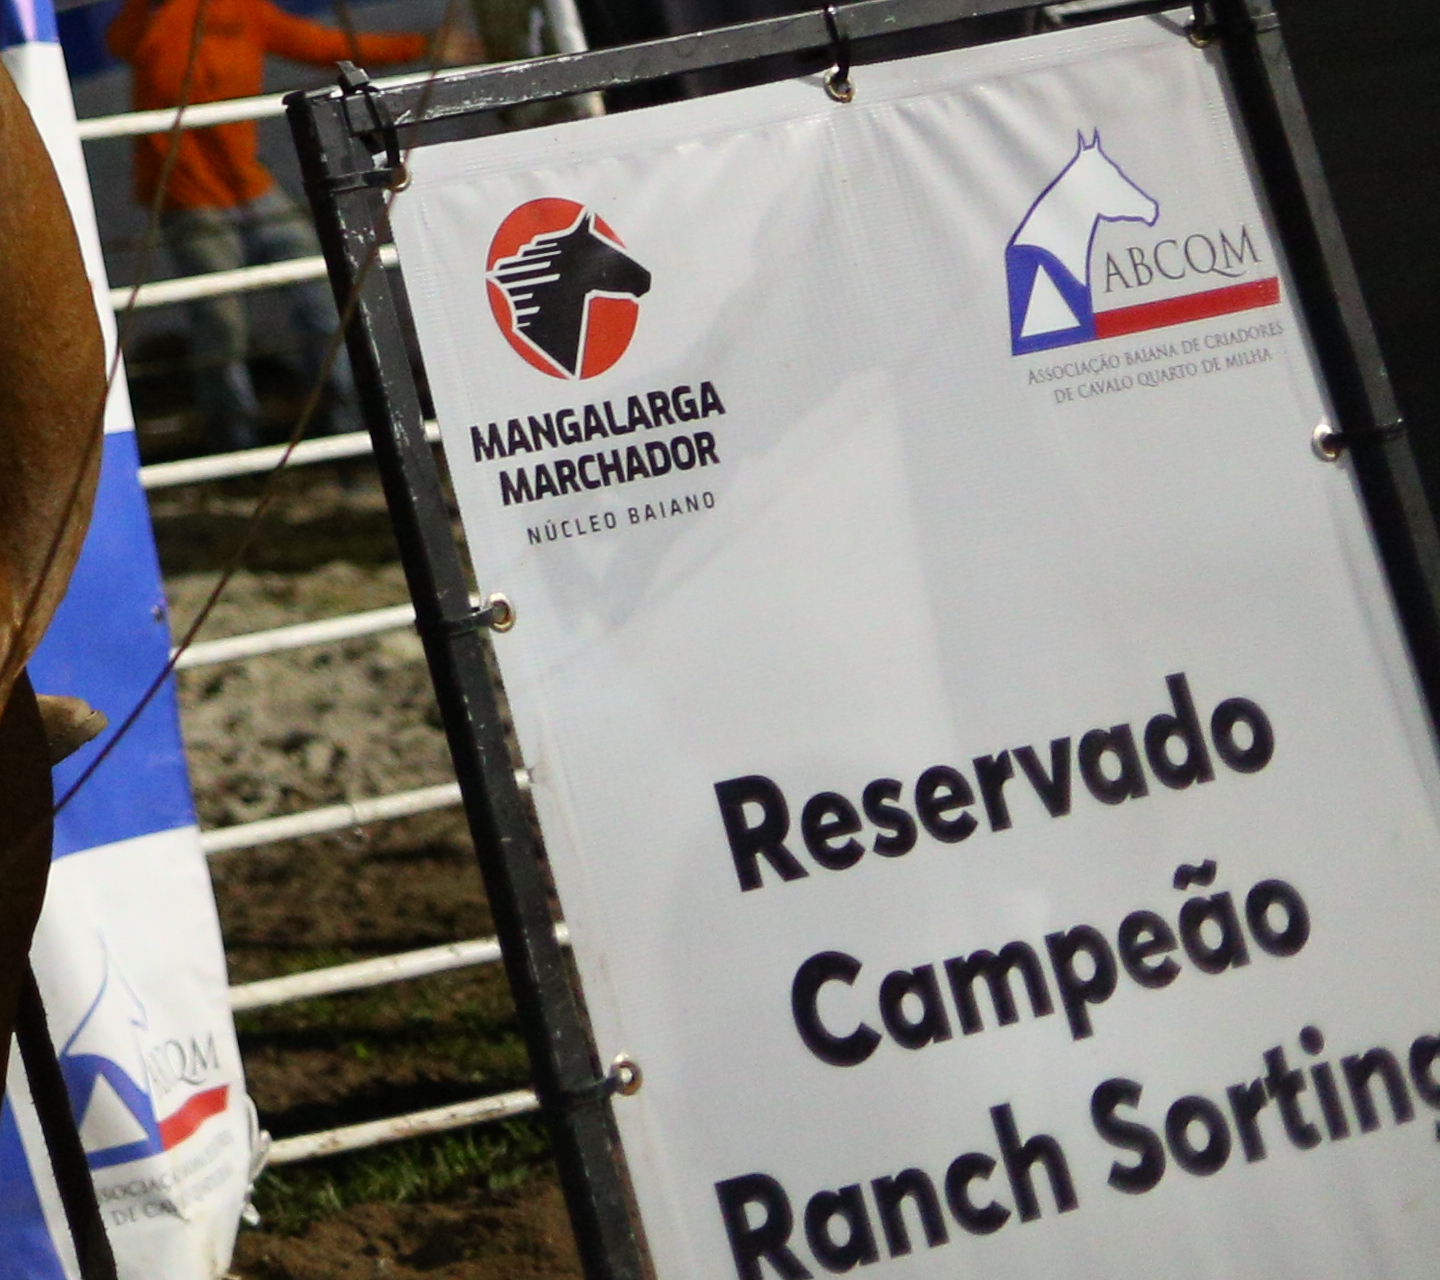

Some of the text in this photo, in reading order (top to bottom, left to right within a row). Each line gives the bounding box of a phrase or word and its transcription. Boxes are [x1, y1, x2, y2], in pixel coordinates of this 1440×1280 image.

[1104, 224, 1263, 293] ABCQM
[1028, 321, 1285, 386] ASSOCIAÇÃO BAIANA DE CRIADORES
[1054, 347, 1274, 404] DE CAVALO QUARTO DE MILHA
[470, 381, 726, 462] MANGALARGA
[499, 431, 720, 506] MARCHADOR
[527, 491, 716, 545] NÚCLEO BAIANO
[714, 672, 1275, 892] Reservado
[791, 859, 1311, 1067] Campeão
[714, 1102, 1079, 1280] Ranch
